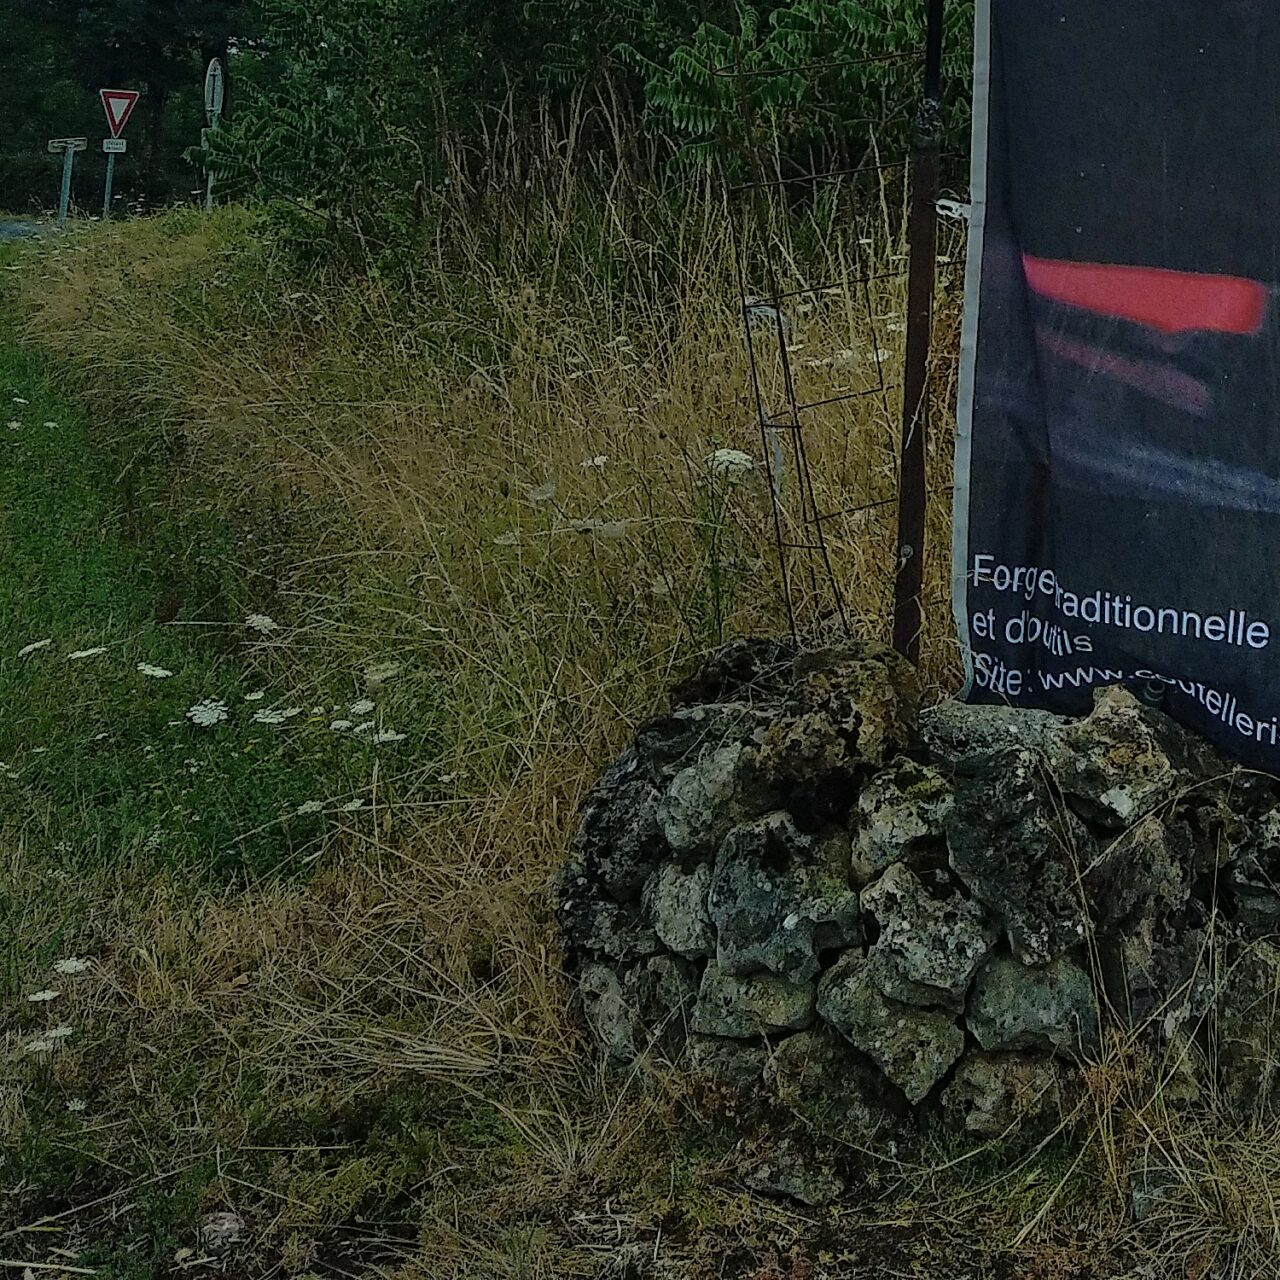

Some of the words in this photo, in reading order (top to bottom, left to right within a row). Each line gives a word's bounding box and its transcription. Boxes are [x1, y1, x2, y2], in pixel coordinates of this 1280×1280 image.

[972, 608, 996, 640] et
[973, 554, 1055, 600] Forge
[1054, 575, 1271, 649] traditionnelle
